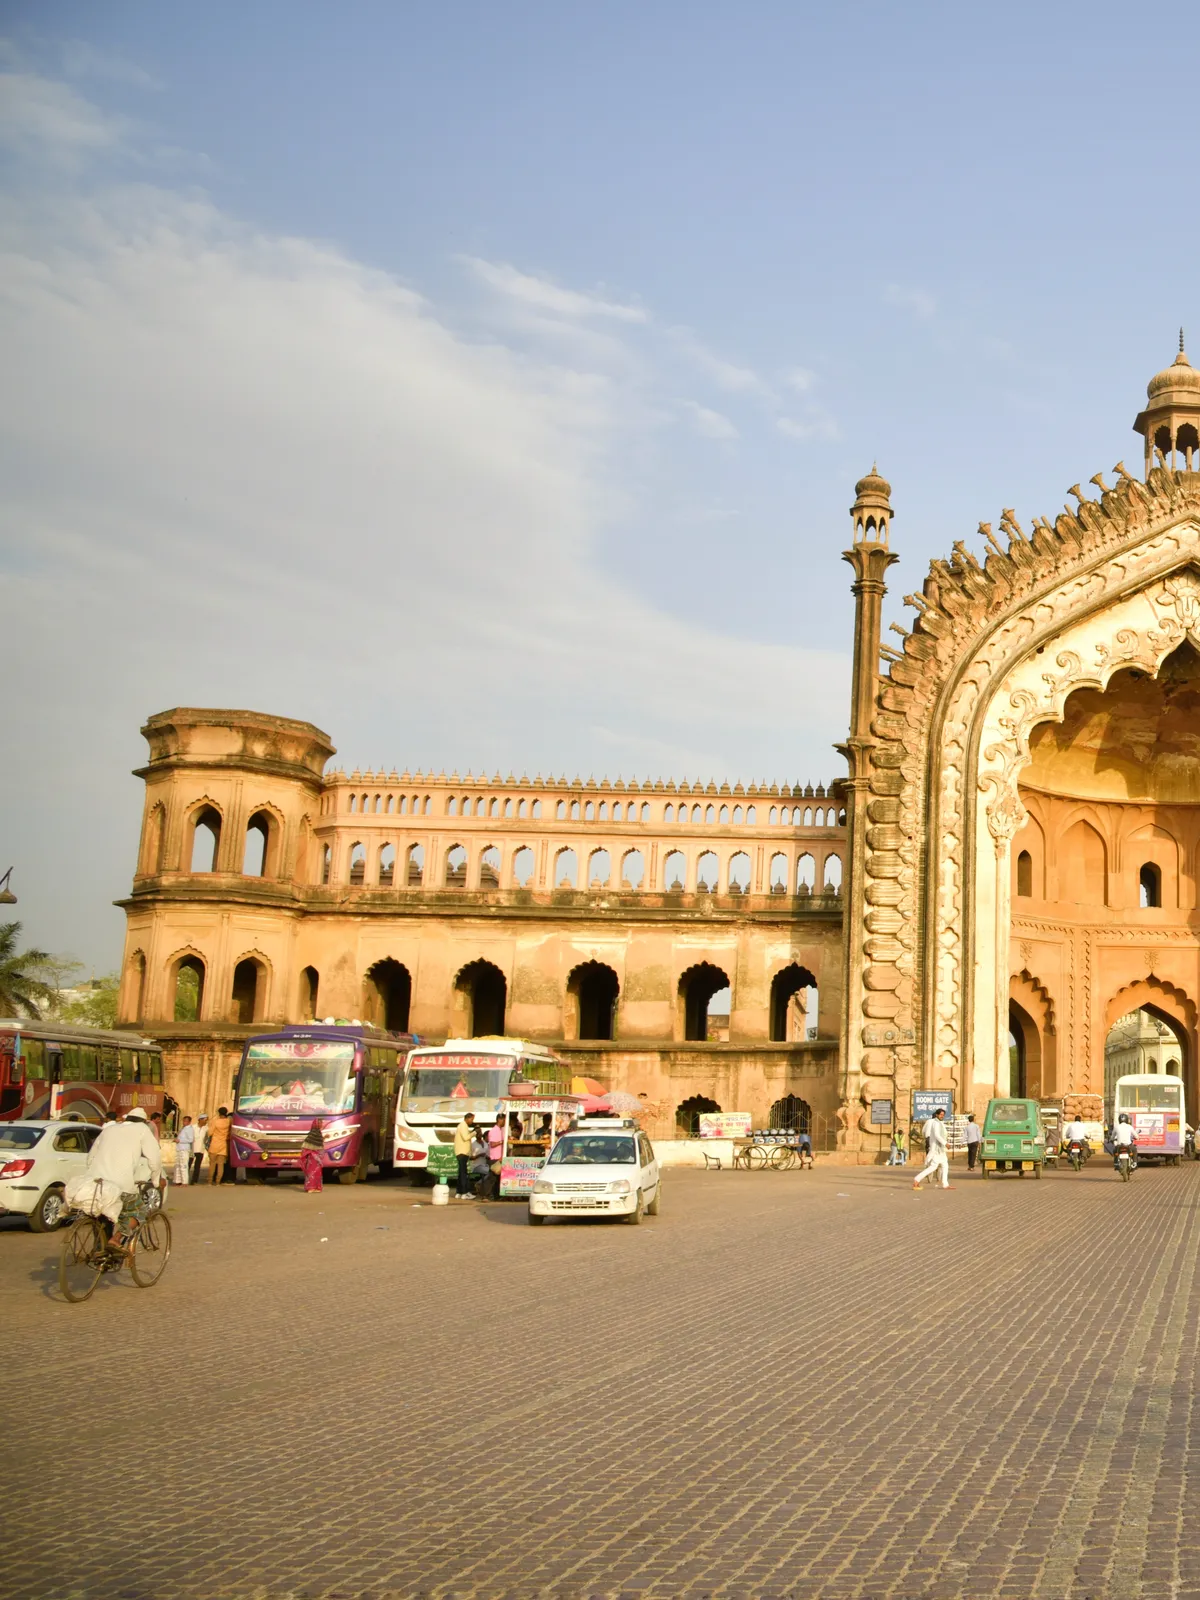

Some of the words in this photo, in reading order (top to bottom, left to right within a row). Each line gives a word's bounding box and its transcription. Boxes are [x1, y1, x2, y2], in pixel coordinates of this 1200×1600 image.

[414, 1056, 442, 1065] JAI
[447, 1055, 492, 1065] MATA
[496, 1056, 514, 1065] DI
